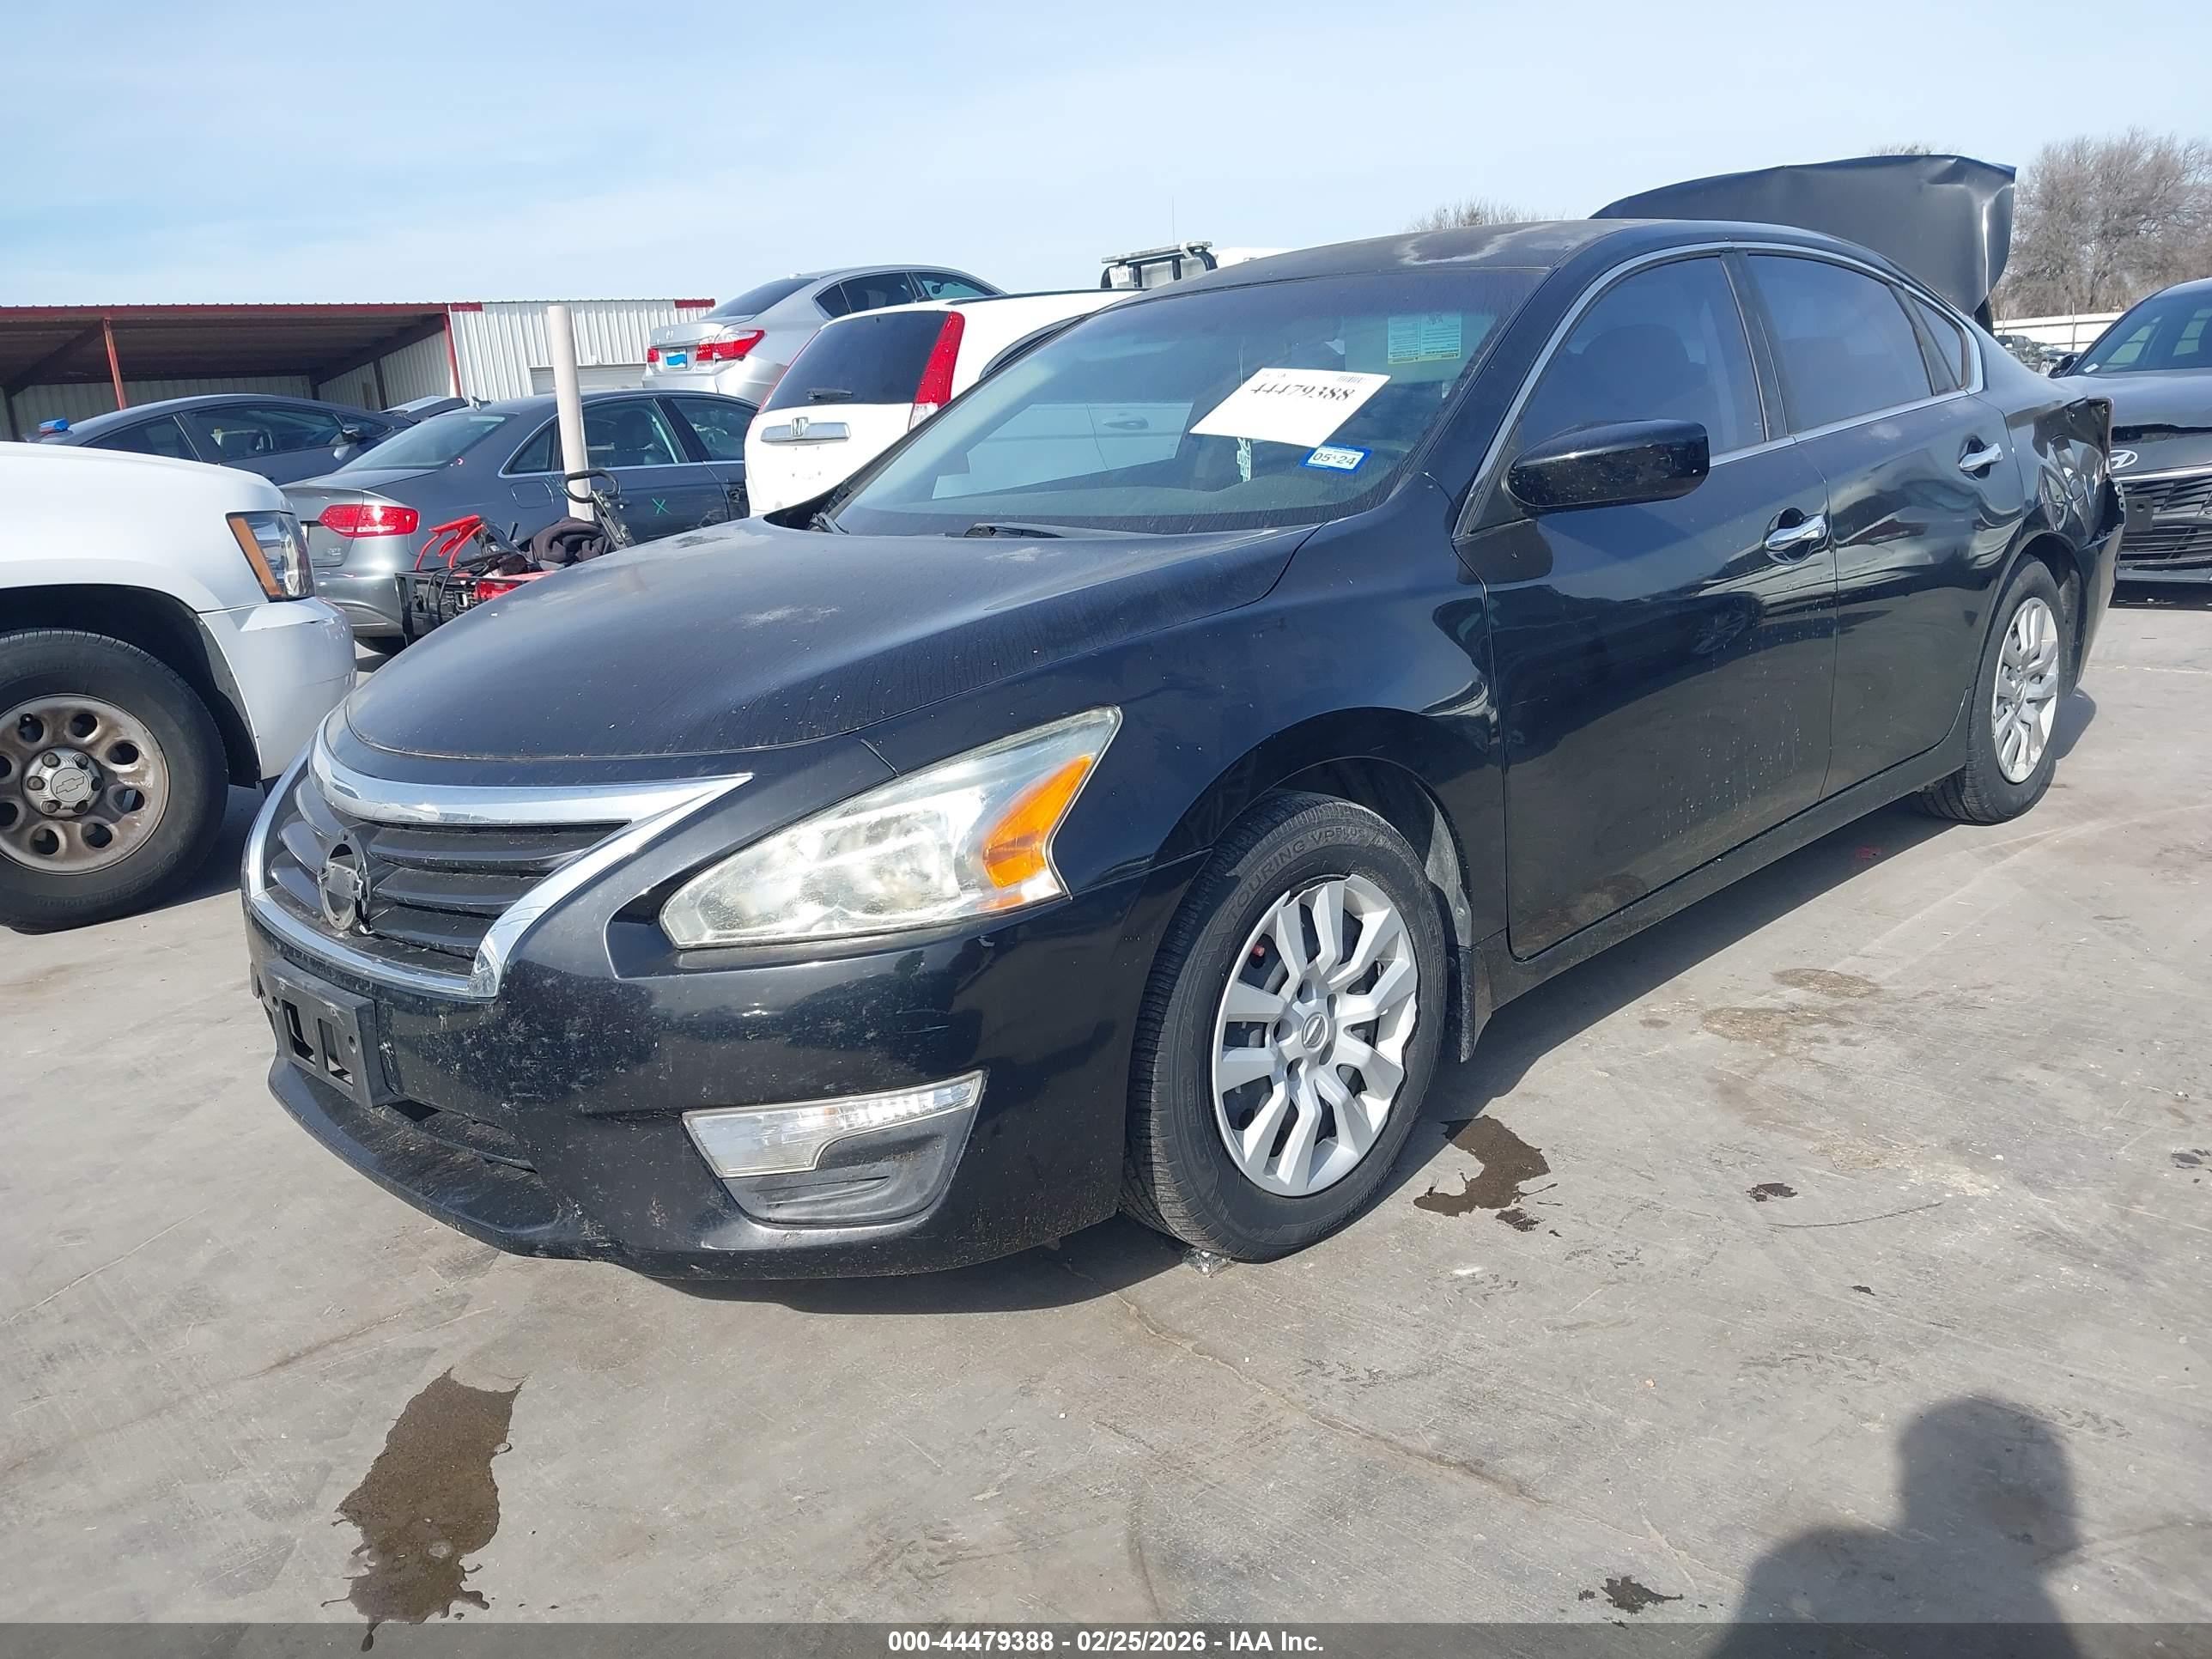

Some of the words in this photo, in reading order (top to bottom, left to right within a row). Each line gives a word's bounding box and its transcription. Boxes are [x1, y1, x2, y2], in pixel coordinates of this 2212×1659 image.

[1250, 383, 1355, 401] 44479388
[1312, 453, 1333, 462] 05
[1336, 455, 1357, 465] 24
[1225, 840, 1306, 922] TOURING
